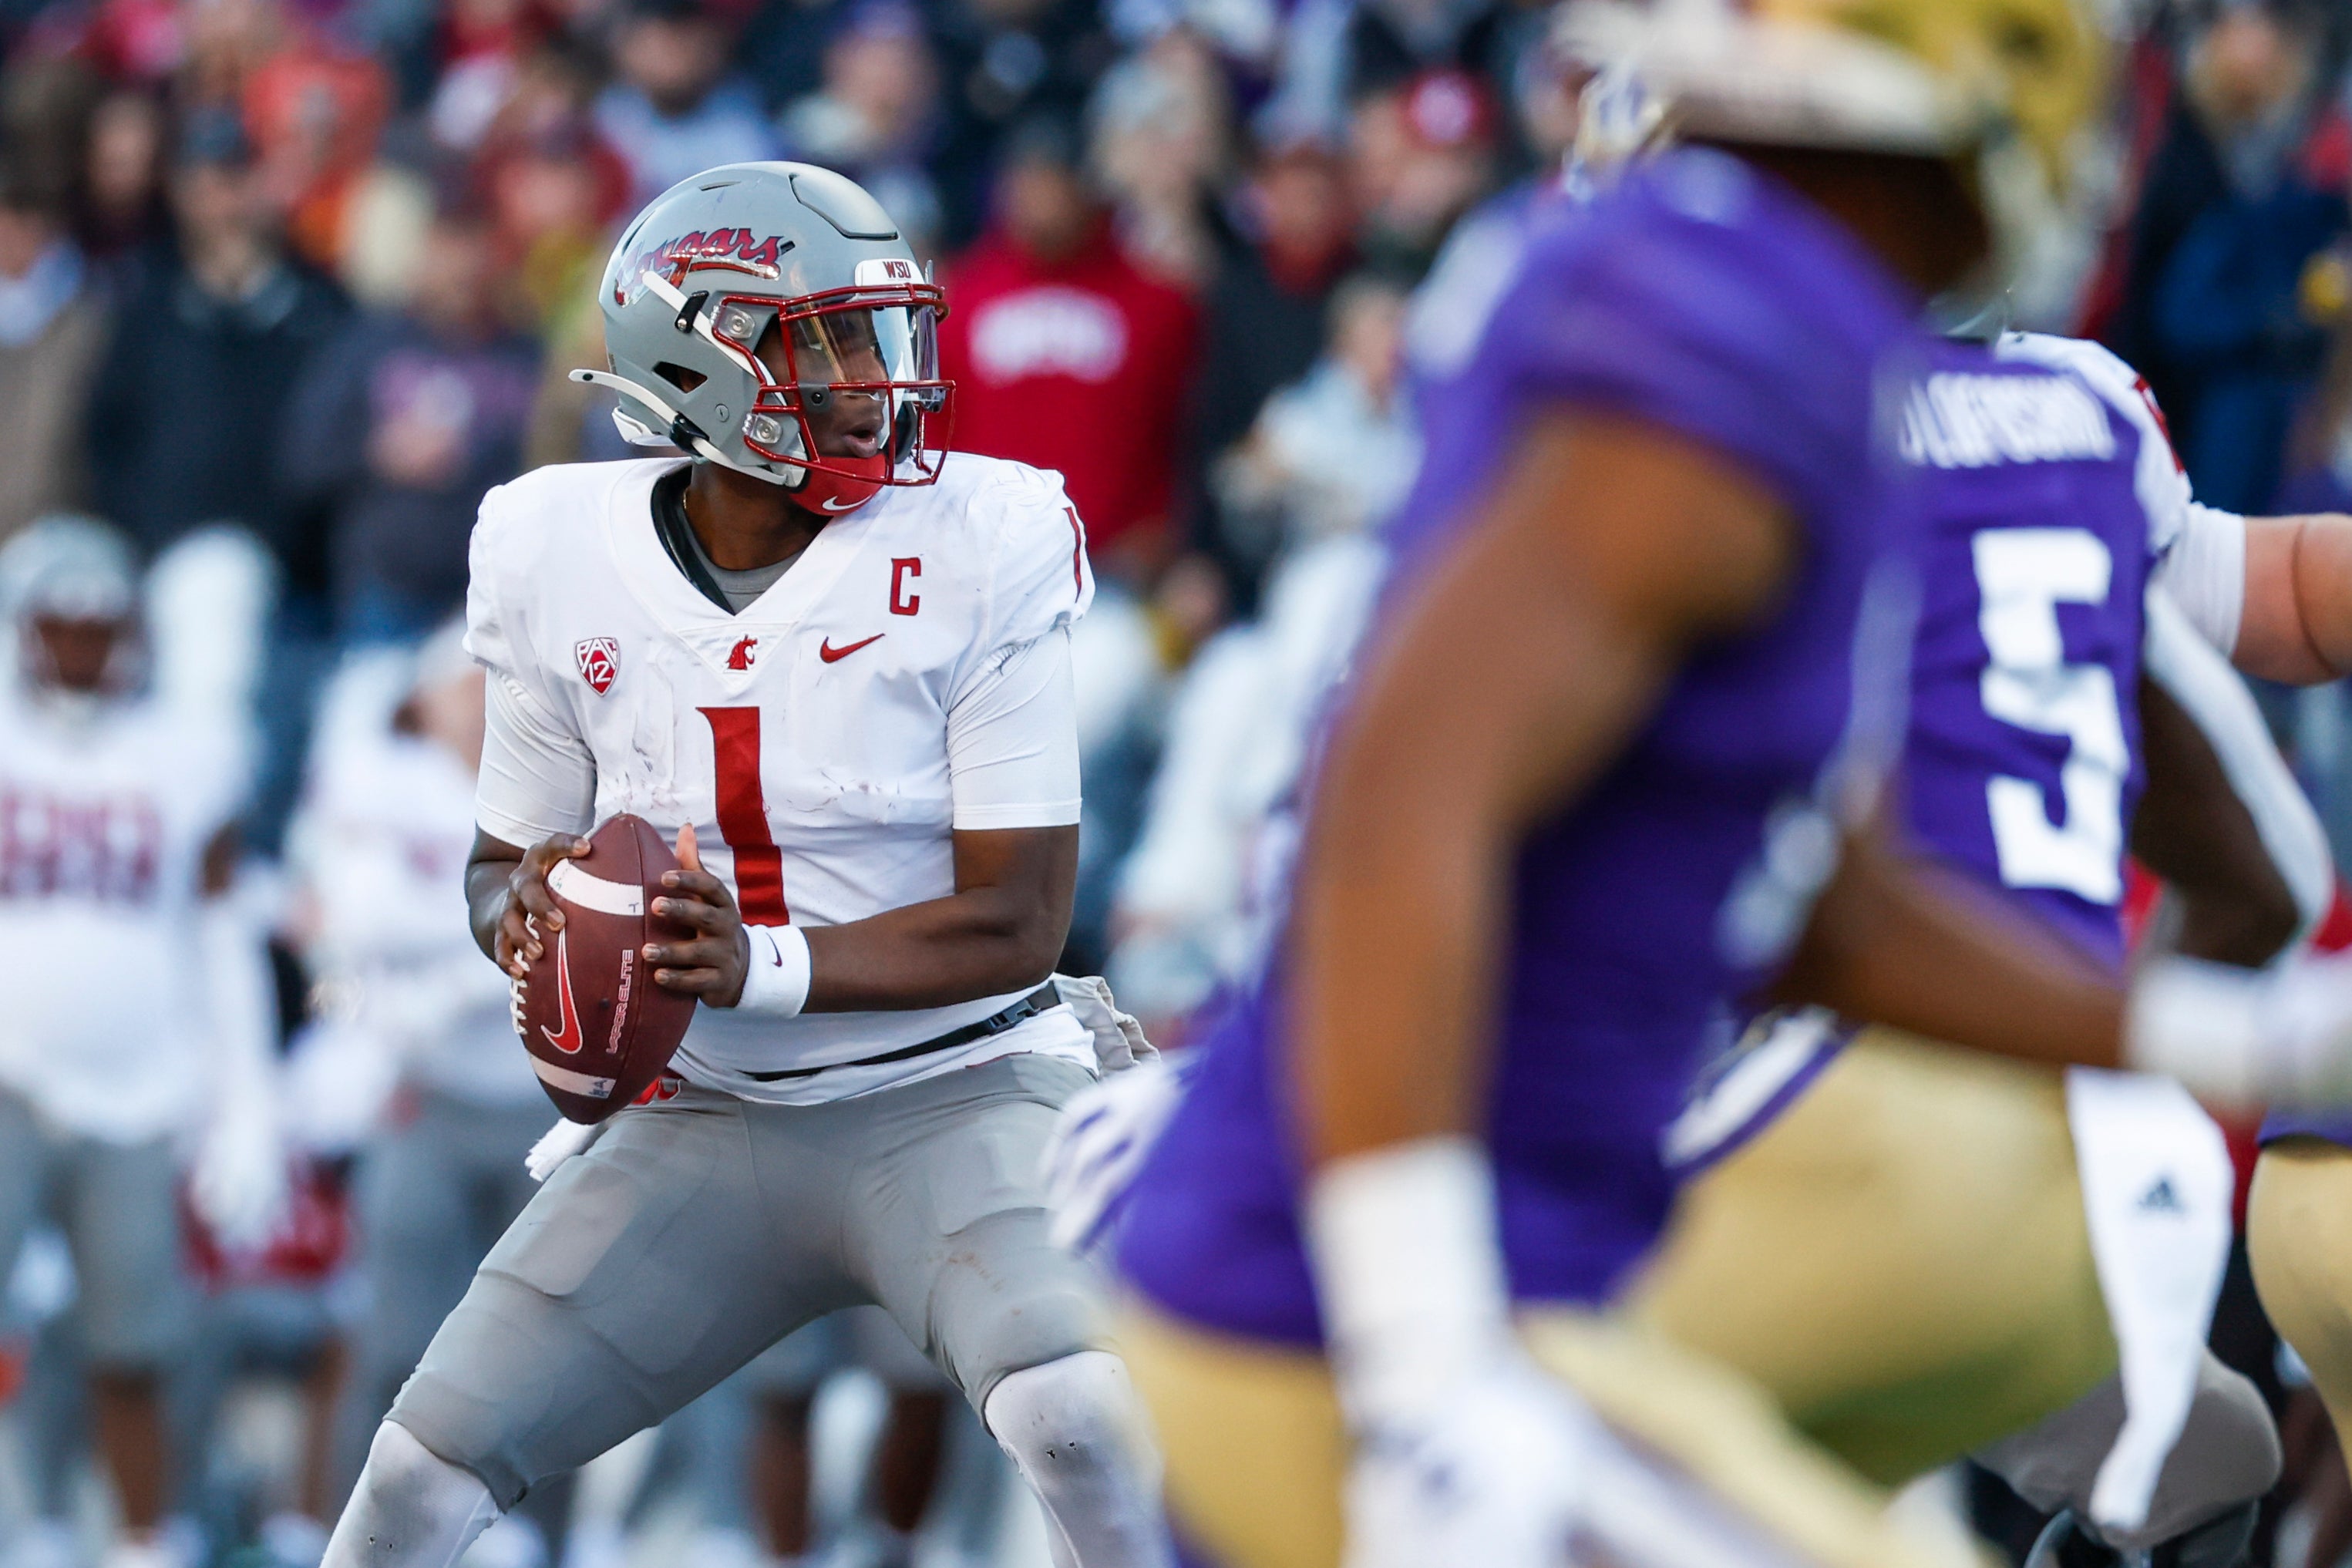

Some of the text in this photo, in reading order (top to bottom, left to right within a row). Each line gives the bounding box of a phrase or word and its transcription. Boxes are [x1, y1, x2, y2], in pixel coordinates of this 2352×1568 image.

[882, 261, 912, 279] WSU
[890, 557, 921, 617] C
[575, 638, 617, 674] PAC
[588, 660, 611, 685] 12
[1973, 527, 2130, 905] 5
[695, 706, 790, 927] 1
[605, 949, 634, 1054] VAPOR ELITE
